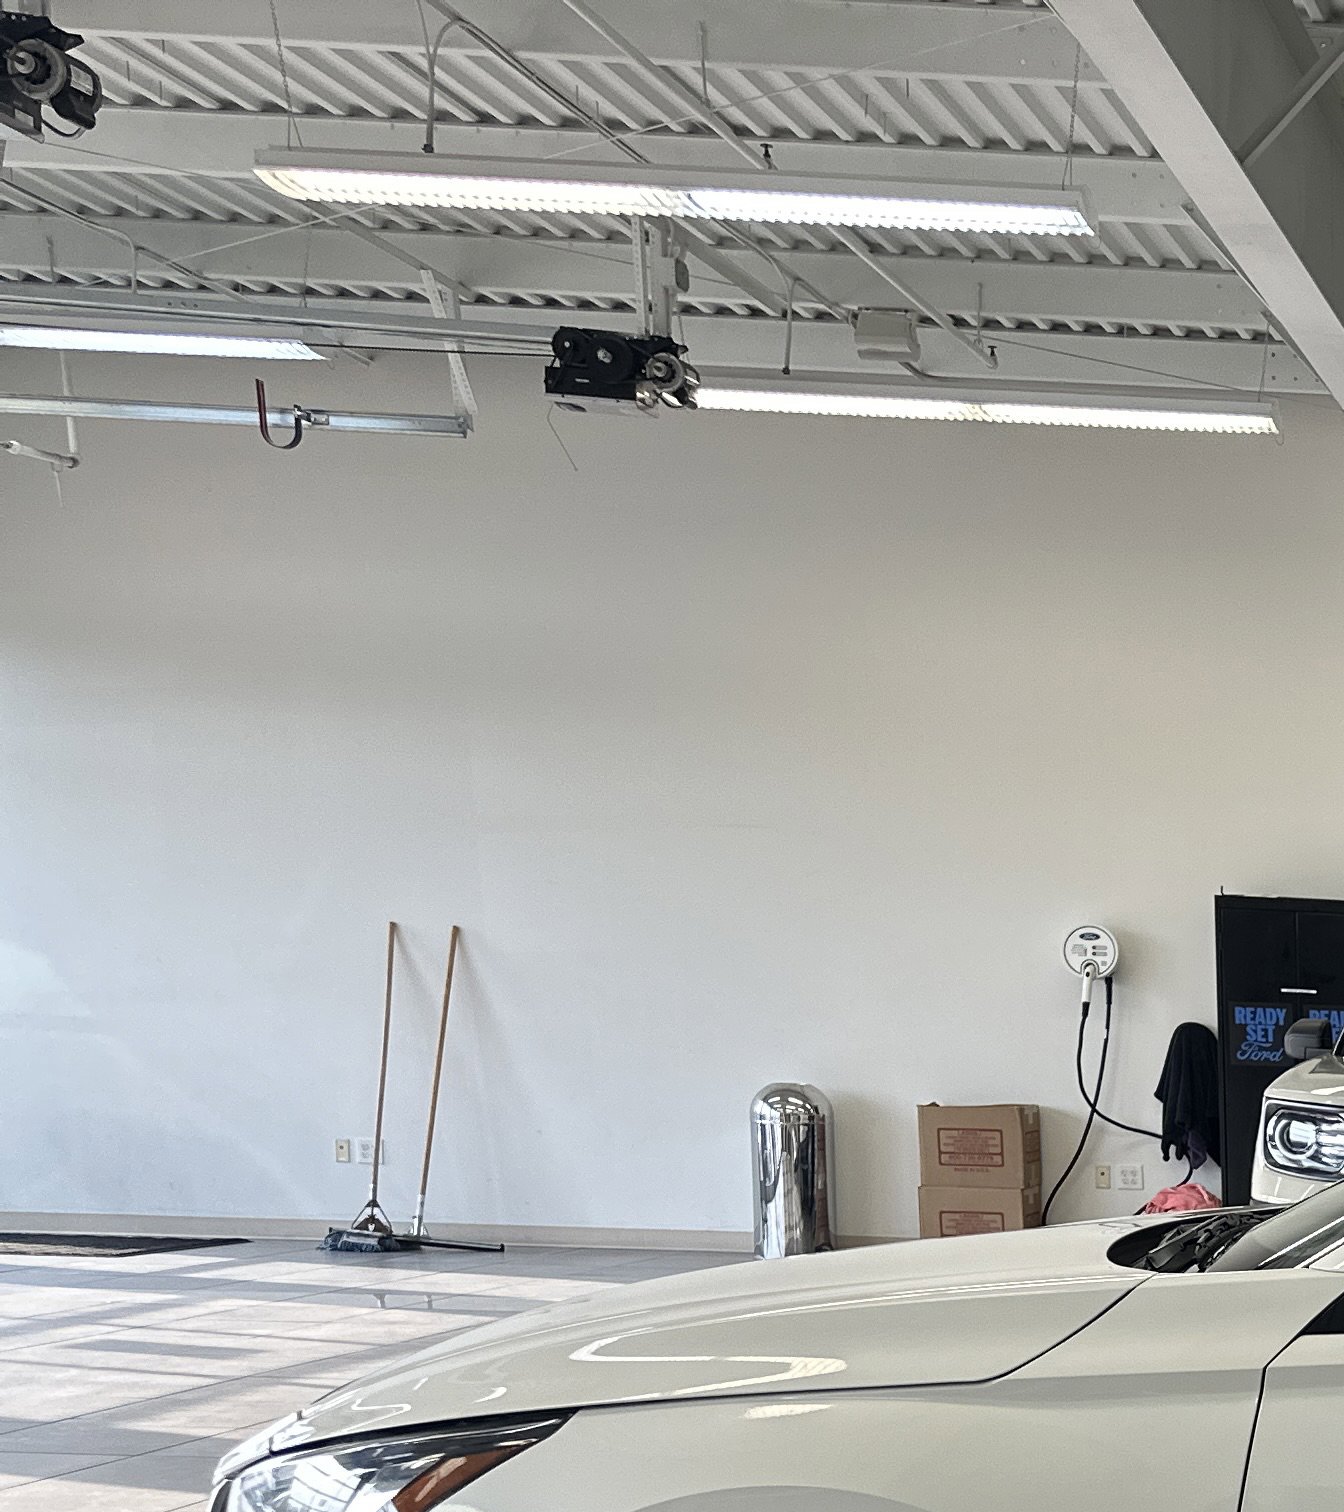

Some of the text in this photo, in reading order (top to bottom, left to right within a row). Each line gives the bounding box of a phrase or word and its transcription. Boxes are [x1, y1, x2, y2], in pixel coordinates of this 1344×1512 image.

[1233, 1006, 1287, 1025] READY
[1245, 1024, 1276, 1042] SET
[1236, 1041, 1285, 1062] Ford
